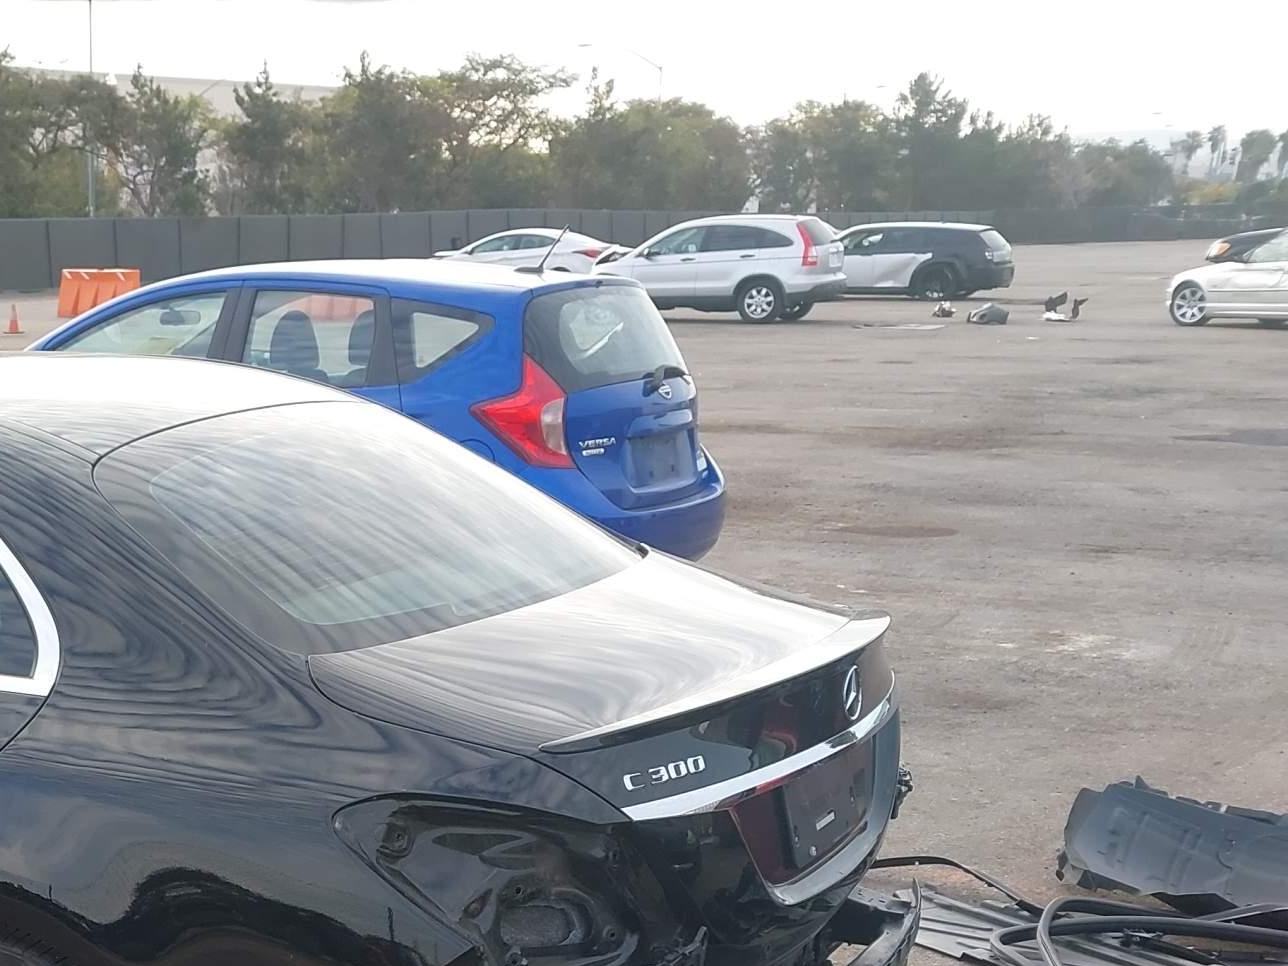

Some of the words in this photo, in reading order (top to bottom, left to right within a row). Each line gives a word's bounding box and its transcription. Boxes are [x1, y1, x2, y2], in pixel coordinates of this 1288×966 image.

[578, 437, 617, 448] VERSA
[623, 772, 646, 791] C
[648, 755, 706, 784] 300
